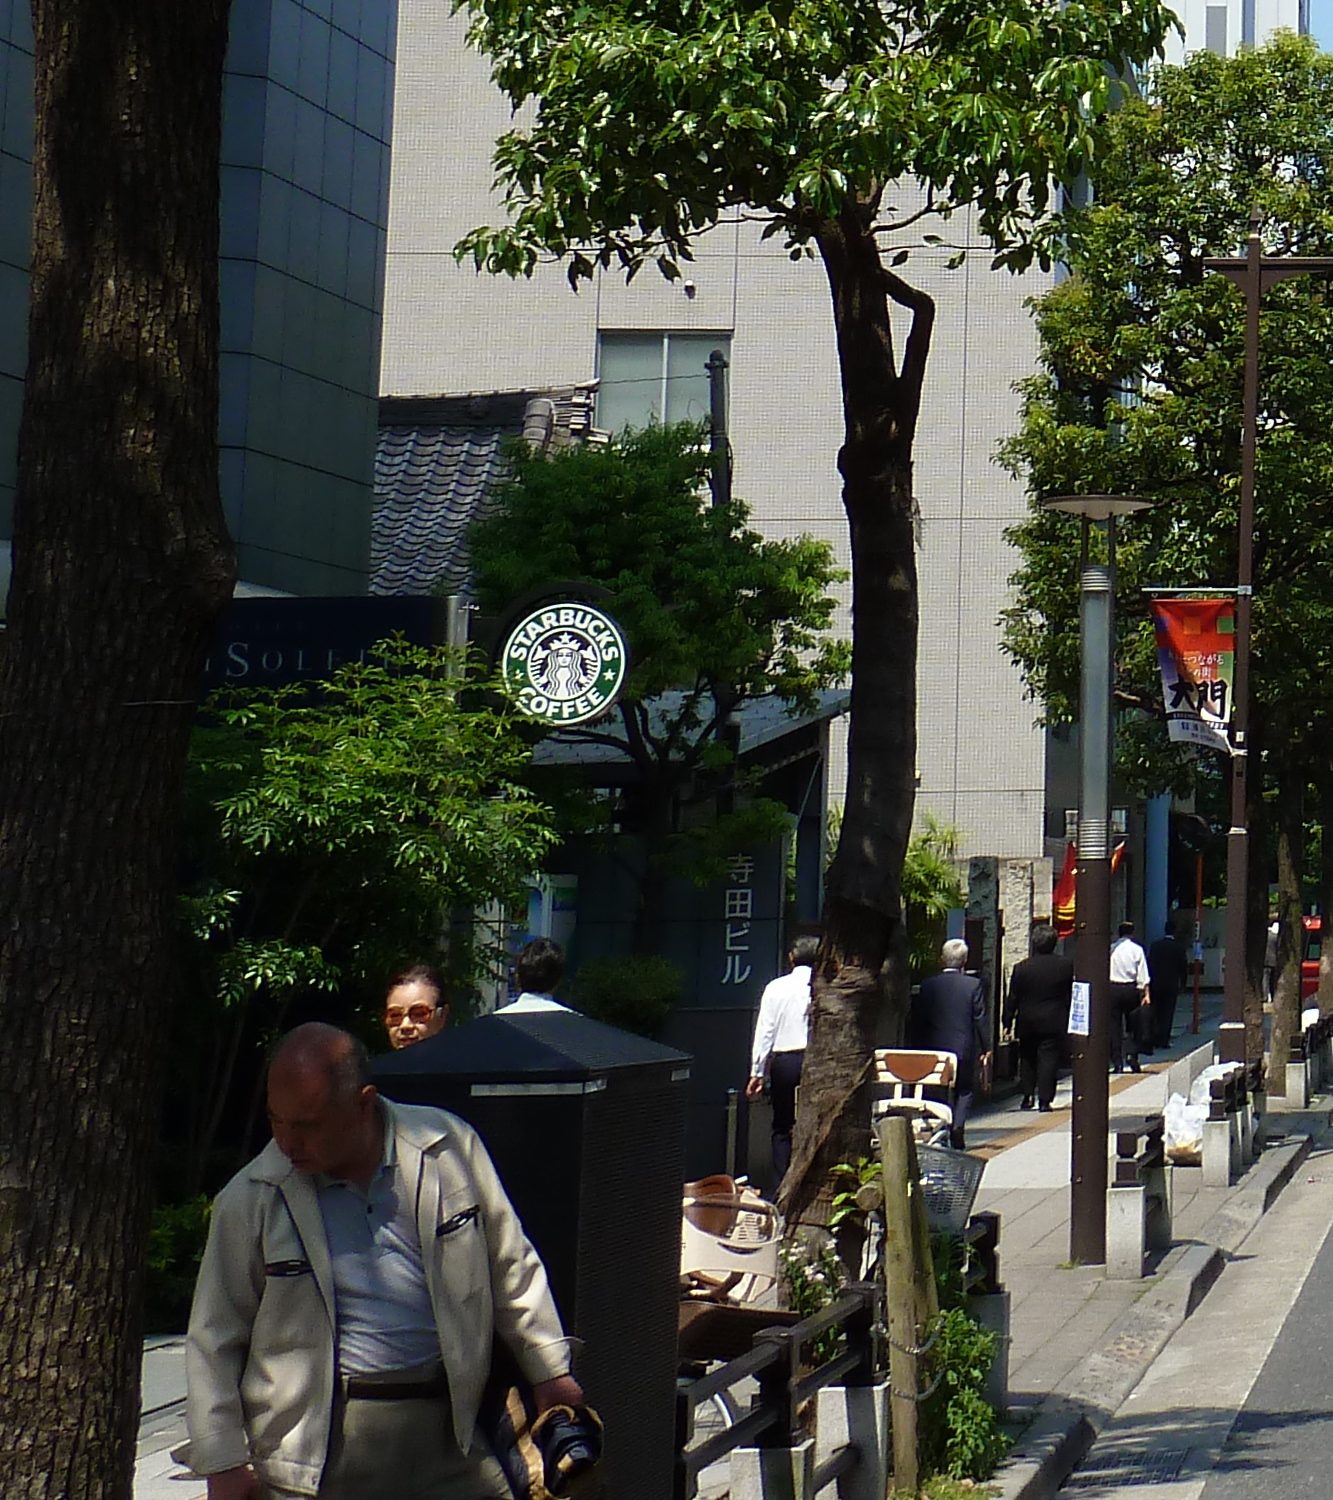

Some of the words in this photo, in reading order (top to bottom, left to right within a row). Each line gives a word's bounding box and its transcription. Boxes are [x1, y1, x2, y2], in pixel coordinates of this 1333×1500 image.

[510, 609, 619, 661] STARBUCKS
[519, 687, 604, 718] COFFEE
[1168, 677, 1228, 720] 大門
[721, 853, 754, 984] 寺田ビル
